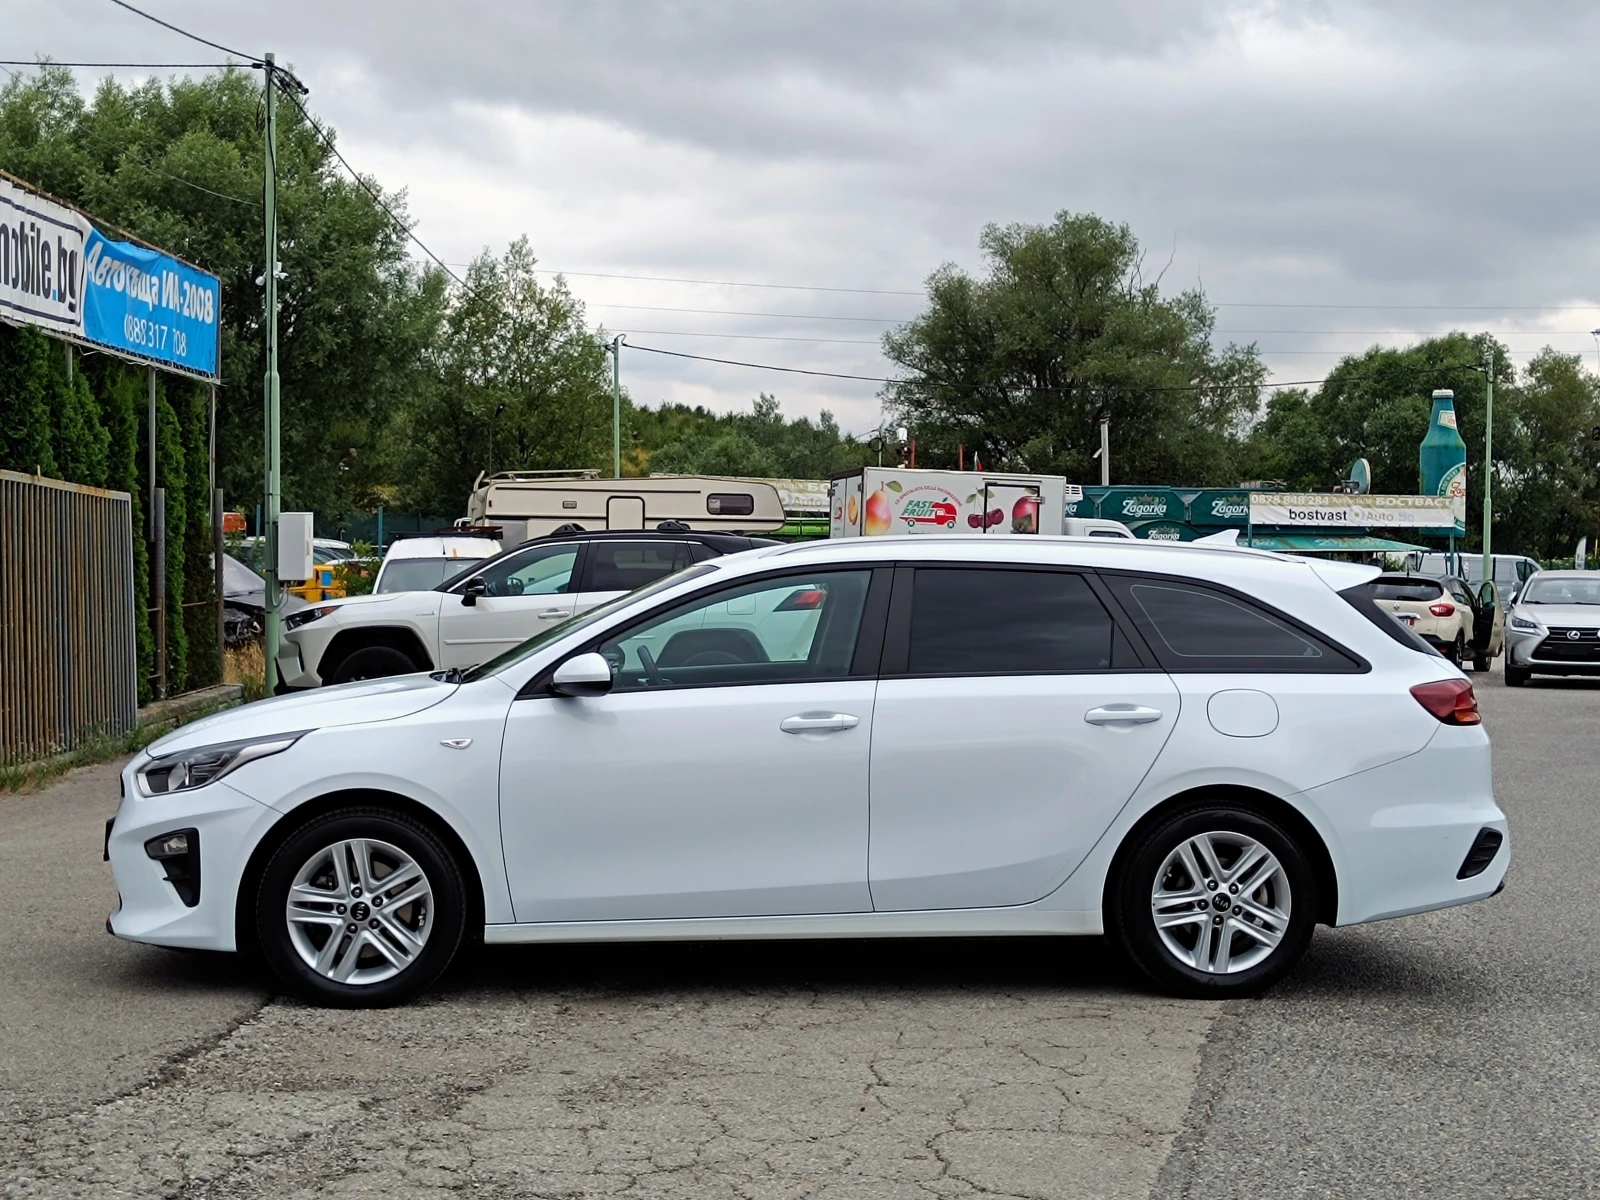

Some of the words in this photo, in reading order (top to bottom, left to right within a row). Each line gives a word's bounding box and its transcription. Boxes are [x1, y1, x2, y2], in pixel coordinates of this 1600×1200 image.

[148, 321, 168, 350] 317
[906, 500, 934, 509] FAST
[1307, 496, 1329, 506] 284
[1376, 497, 1452, 506] БОСТВАСТ
[901, 508, 935, 517] FRUIT
[1122, 500, 1167, 517] Zagorka
[1211, 500, 1248, 518] Zagork
[1289, 508, 1347, 521] bostvast
[1148, 529, 1180, 541] Zagorka
[1214, 896, 1229, 909] KIA
[356, 903, 366, 920] KIA
